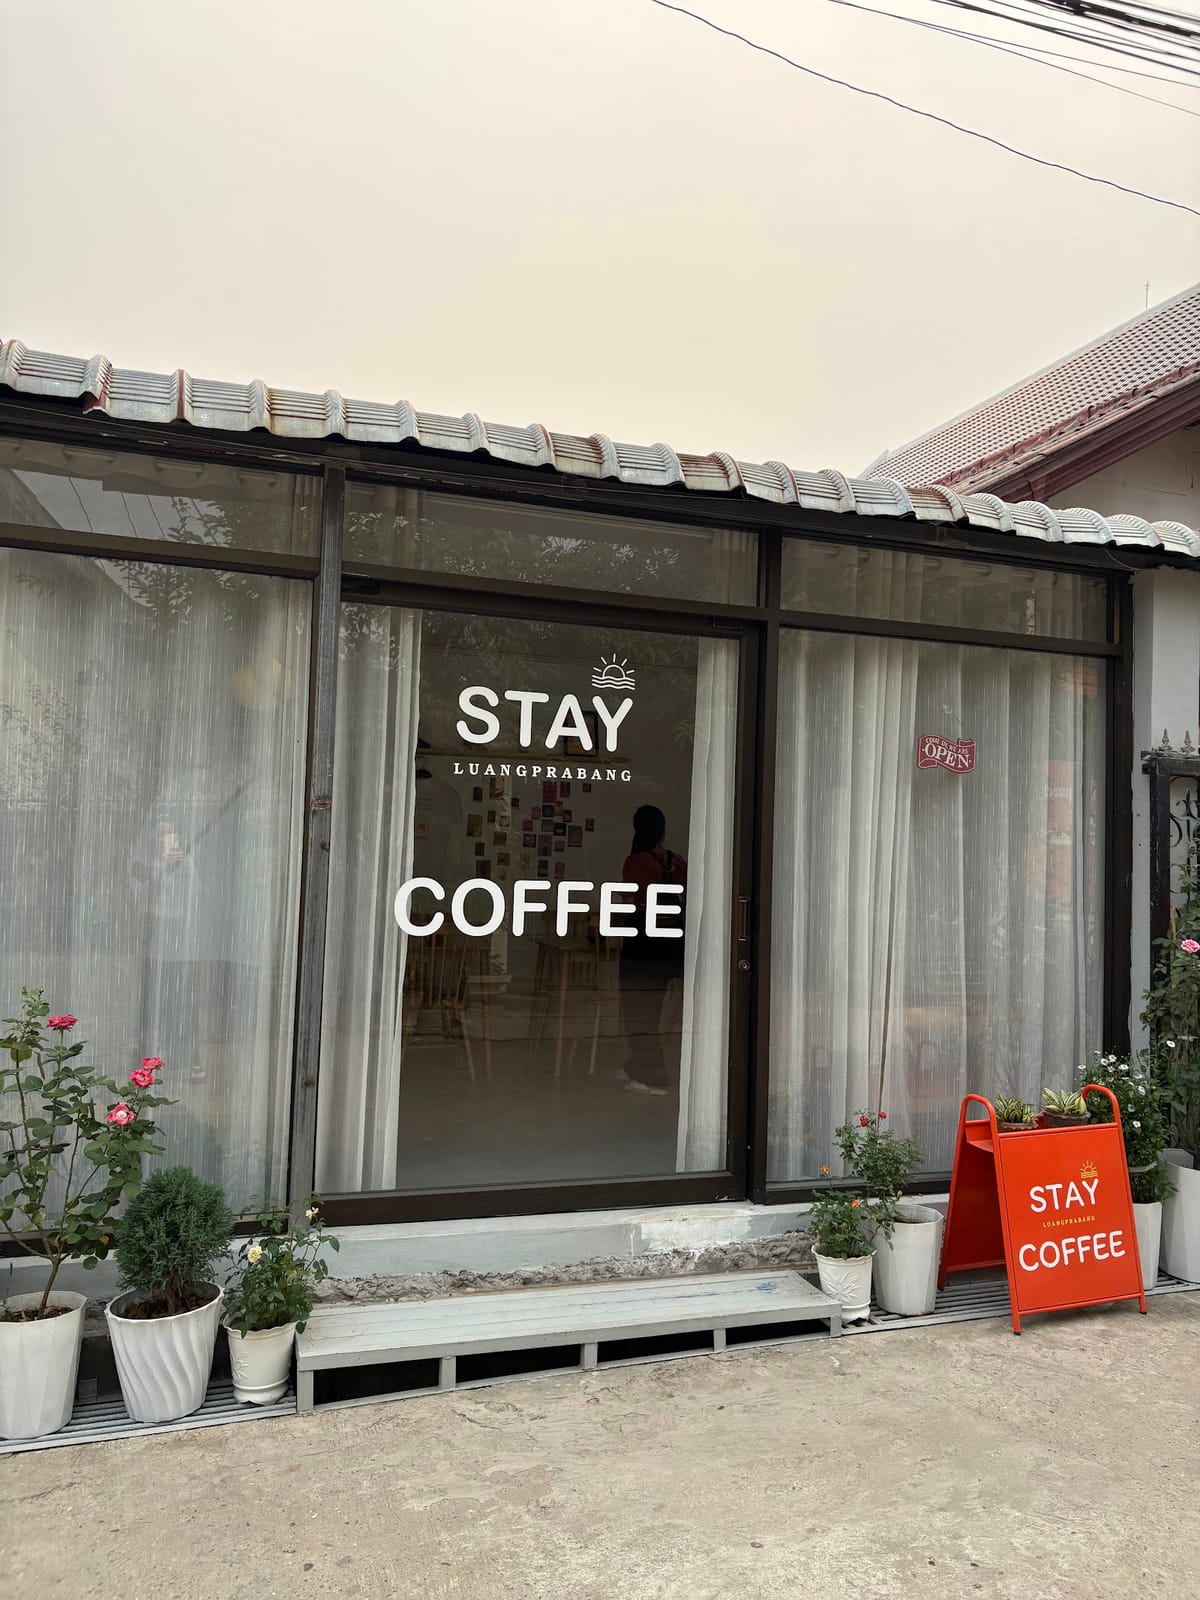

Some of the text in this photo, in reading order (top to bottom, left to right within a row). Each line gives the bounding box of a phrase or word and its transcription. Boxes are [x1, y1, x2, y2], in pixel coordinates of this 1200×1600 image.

[456, 686, 633, 752] STAY
[453, 762, 632, 782] LUANGPRABANG
[924, 742, 970, 768] OPEN
[394, 877, 685, 938] COFFEE
[1029, 1178, 1099, 1213] STAY
[1043, 1215, 1096, 1228] LUANGPRABANG
[1018, 1230, 1126, 1272] COFFEE
